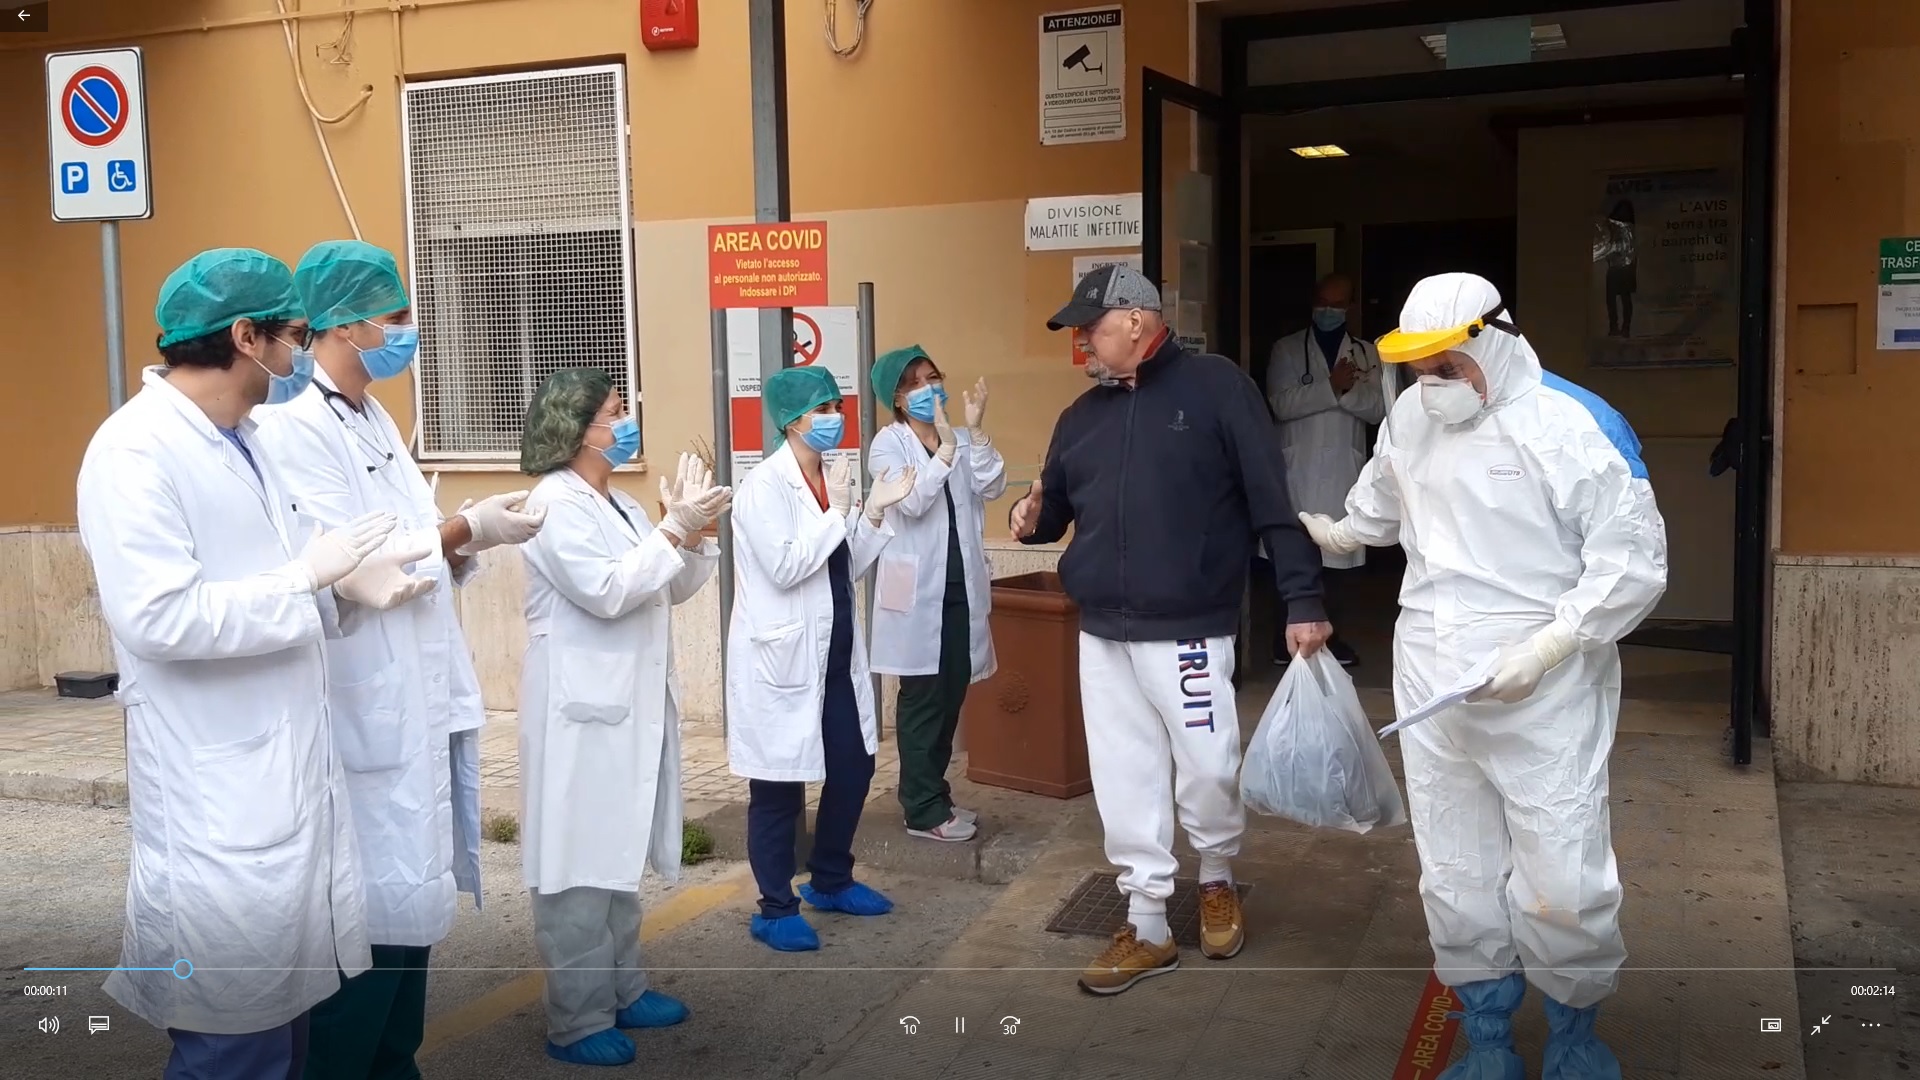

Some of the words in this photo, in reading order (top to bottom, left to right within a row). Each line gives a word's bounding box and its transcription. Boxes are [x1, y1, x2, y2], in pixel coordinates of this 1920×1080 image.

[1048, 13, 1116, 29] ATTENZIONE!
[66, 165, 84, 191] P
[1047, 204, 1122, 220] DIVISIONE
[1680, 199, 1728, 213] L'AVIS
[1030, 223, 1079, 239] MALATTIE
[1087, 220, 1140, 237] INFETTIVE
[713, 231, 763, 253] AREA
[766, 229, 822, 251] COVID
[1905, 240, 1920, 252] CE
[736, 258, 762, 270] Vietato
[763, 257, 800, 269] l'accesso
[1092, 261, 1128, 269] INGRESO
[1880, 256, 1919, 269] TRASF
[714, 273, 721, 284] al
[723, 272, 759, 286] personale
[761, 274, 776, 283] non
[778, 271, 823, 282] autorizzato.
[739, 286, 777, 297] Indossare
[783, 285, 797, 296] DPI
[1176, 638, 1215, 733] FRUIT
[1424, 995, 1453, 1032] COVID
[1411, 1034, 1441, 1070] AREA
